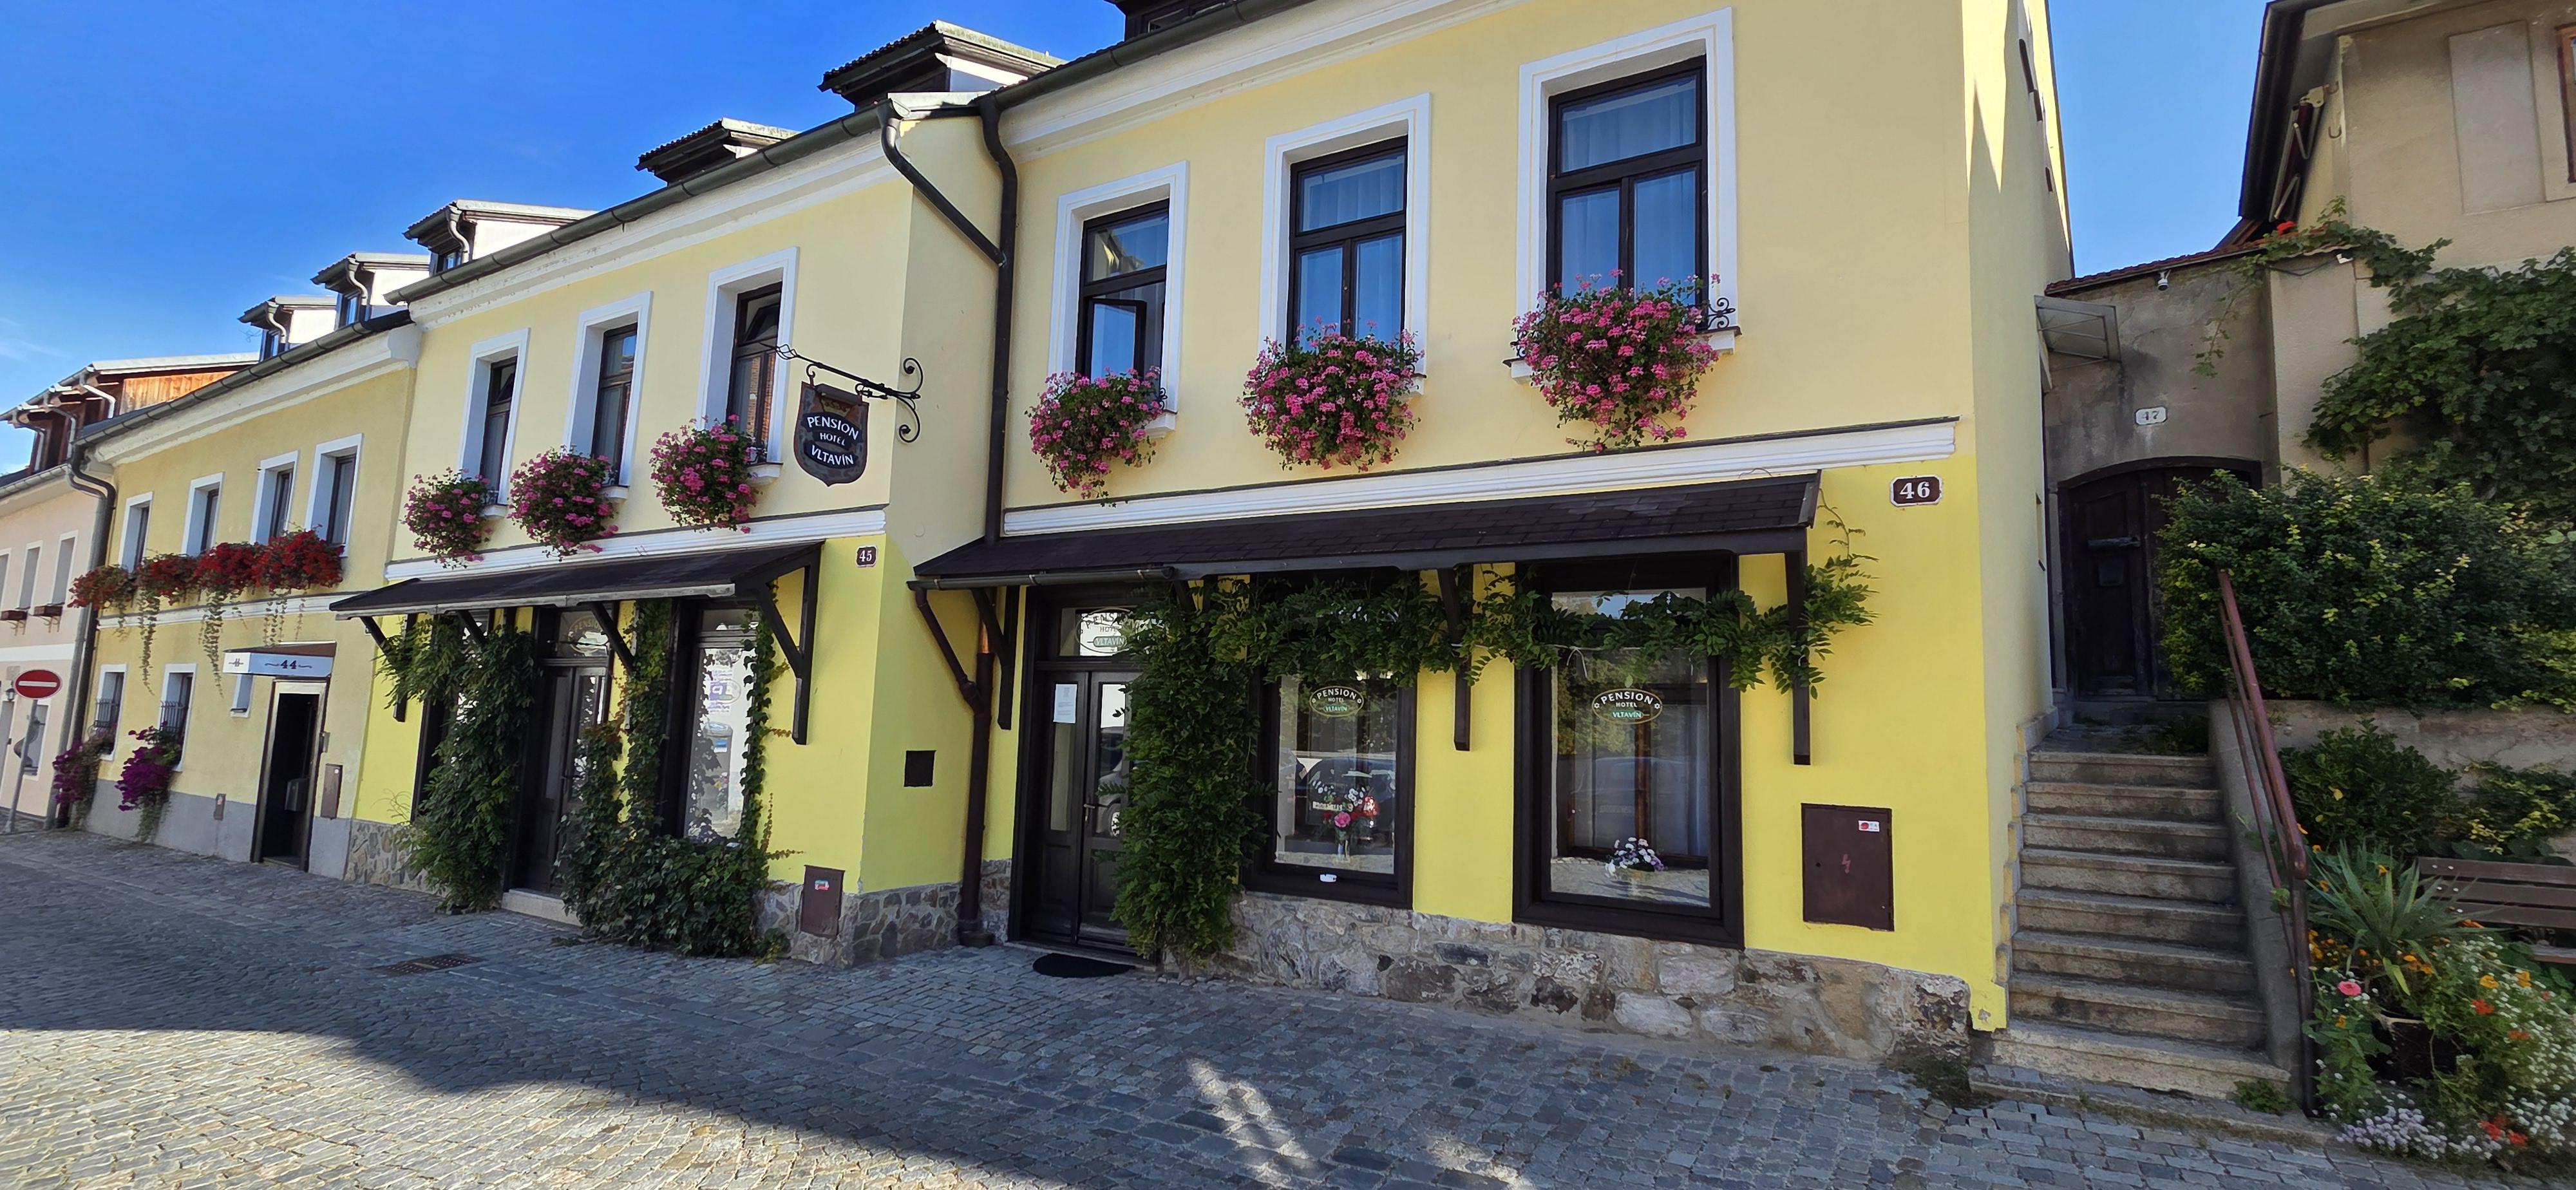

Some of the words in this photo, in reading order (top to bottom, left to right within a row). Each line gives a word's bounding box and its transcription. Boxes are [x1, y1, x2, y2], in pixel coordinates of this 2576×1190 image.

[2141, 410, 2161, 421] 47
[807, 416, 859, 440] PENSION
[820, 432, 846, 446] HOTEL
[1899, 481, 1931, 499] 46
[859, 550, 873, 562] 45
[280, 659, 297, 669] 44
[1316, 688, 1357, 700] PENSION
[1600, 691, 1654, 705] PENSION
